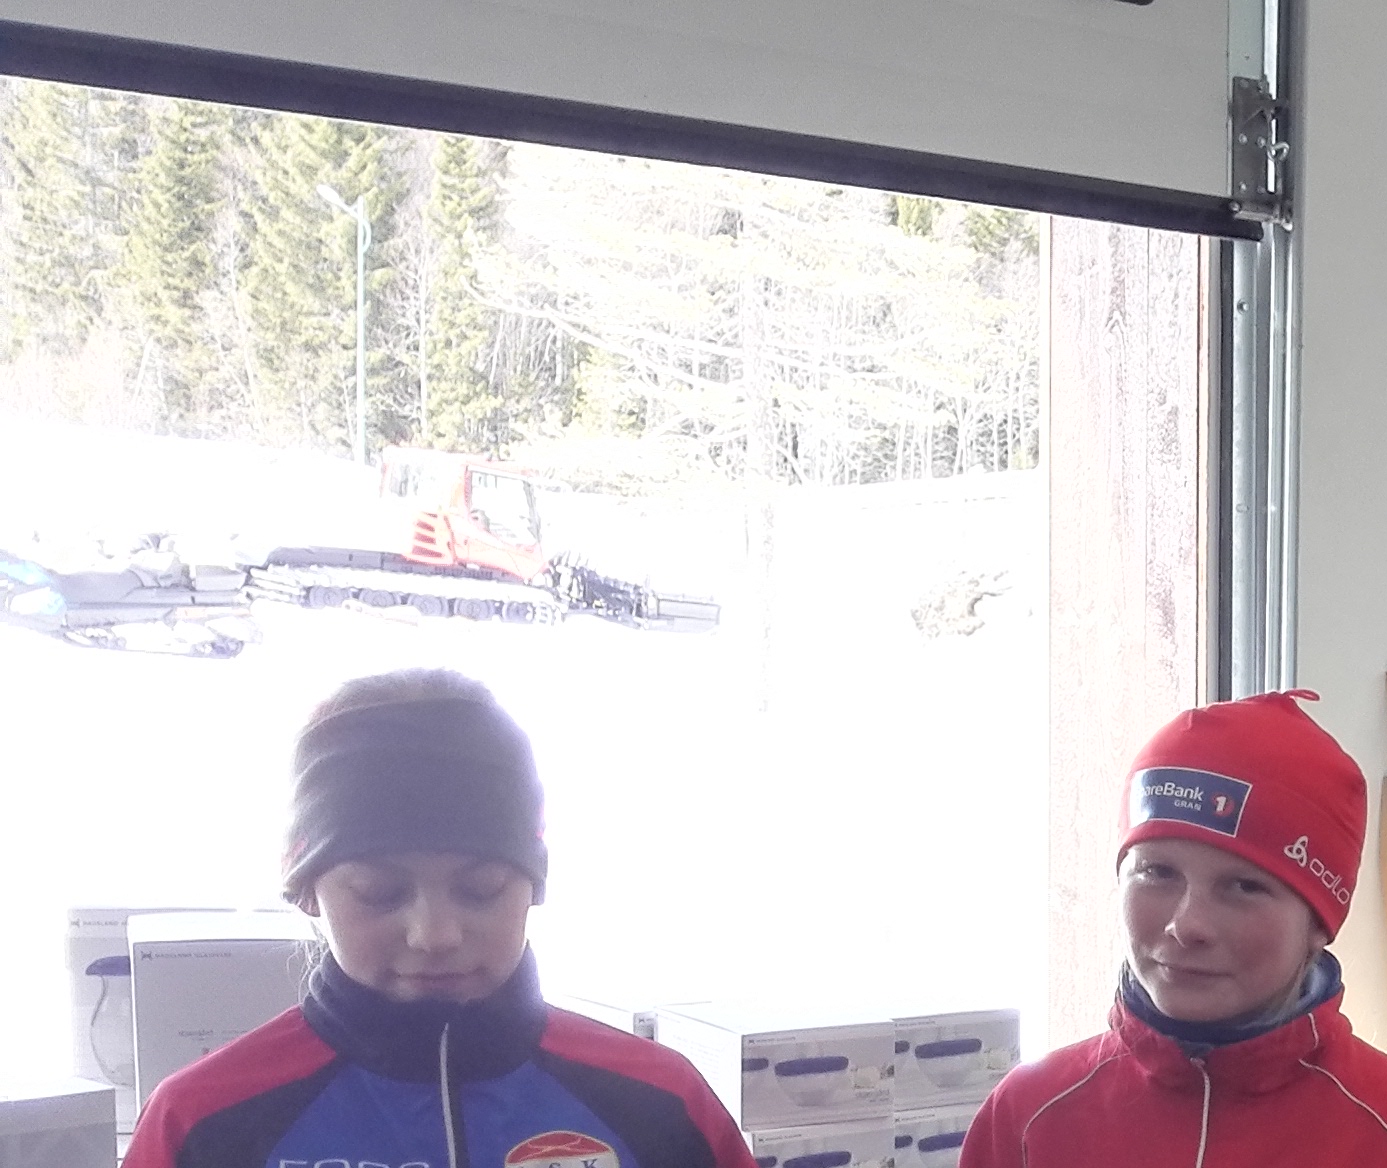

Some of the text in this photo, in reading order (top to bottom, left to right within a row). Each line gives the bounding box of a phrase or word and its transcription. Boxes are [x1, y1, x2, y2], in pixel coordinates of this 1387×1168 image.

[1143, 782, 1203, 801] areBank
[1173, 799, 1201, 811] GRAN
[1309, 857, 1350, 905] odlo
